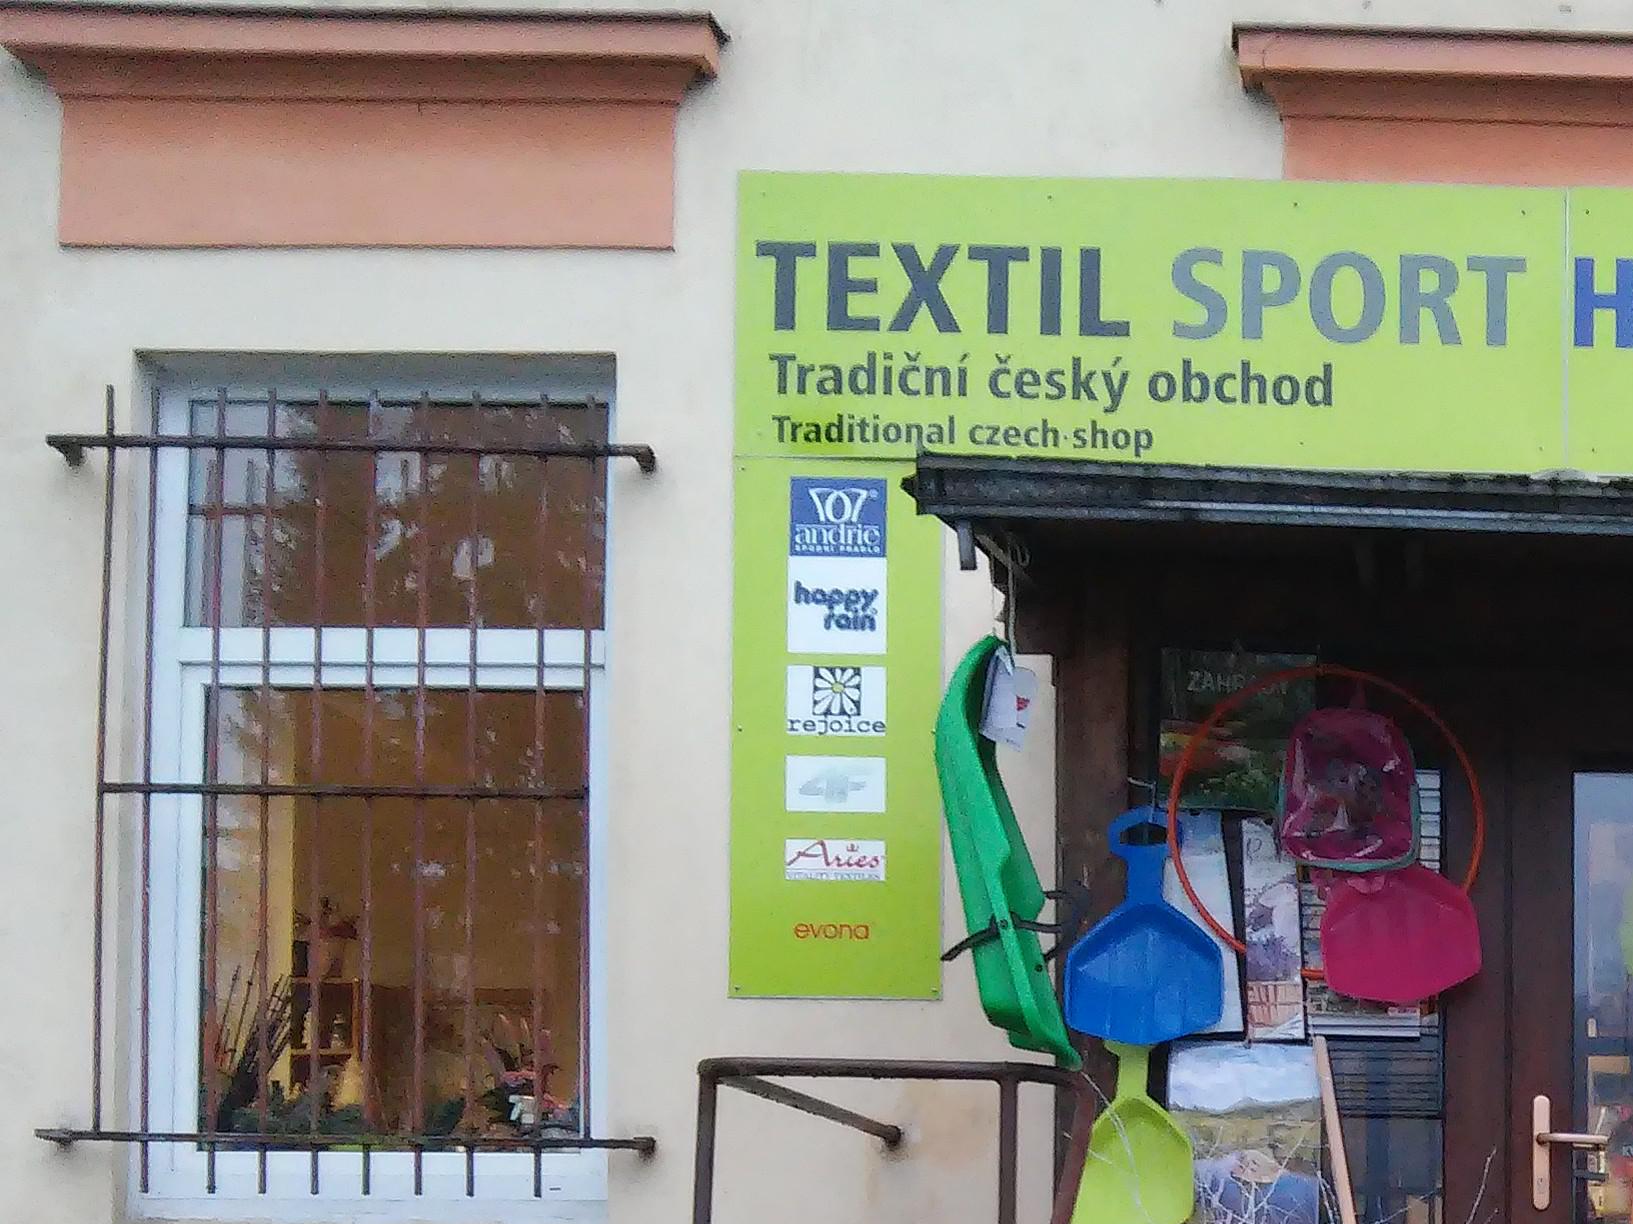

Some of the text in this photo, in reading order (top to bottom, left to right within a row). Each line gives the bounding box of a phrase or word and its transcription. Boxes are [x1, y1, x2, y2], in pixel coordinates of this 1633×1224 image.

[756, 240, 1130, 338] TEXTIL
[1171, 248, 1526, 347] SPORT
[769, 351, 1334, 413] Tradiční český obchod
[772, 415, 1153, 456] Traditional czech shop
[794, 580, 878, 611] happy
[824, 605, 876, 632] rain
[788, 714, 886, 735] rejoice
[787, 840, 880, 868] Aries
[794, 922, 870, 940] evona
